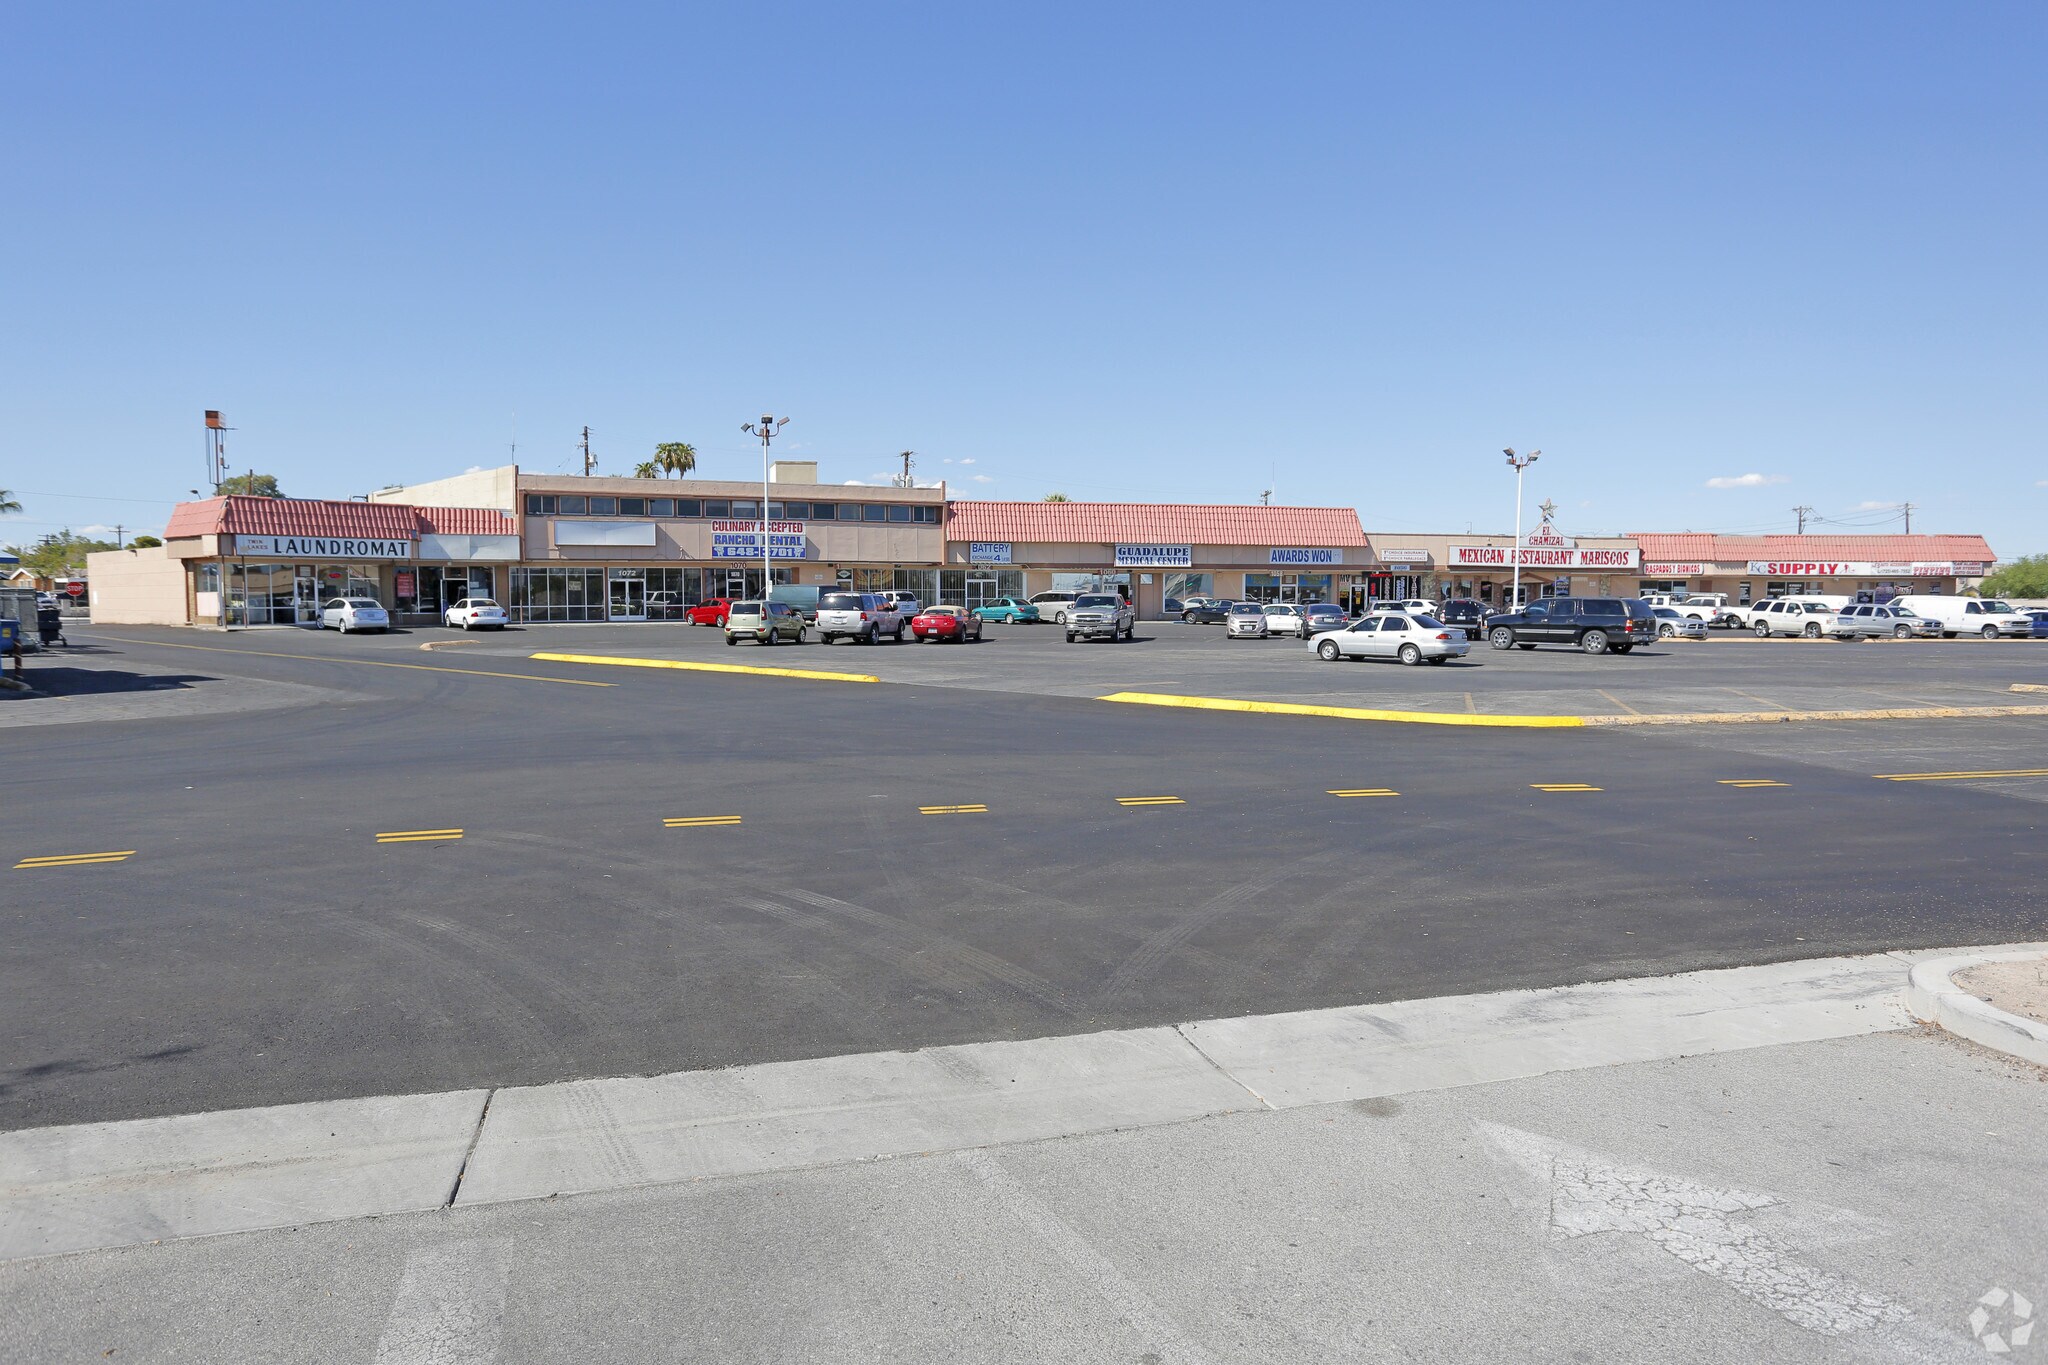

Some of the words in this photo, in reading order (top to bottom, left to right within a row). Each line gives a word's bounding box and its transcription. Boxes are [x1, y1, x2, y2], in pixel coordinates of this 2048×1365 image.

[712, 521, 756, 532] CULINARY
[1542, 526, 1551, 535] EL
[714, 534, 755, 545] RANCHO
[1528, 536, 1564, 546] CHAMIZAL
[274, 538, 407, 556] LAUNDROMAT
[972, 543, 1009, 553] BATTERY
[1118, 547, 1189, 556] GUADALUPE
[993, 554, 1001, 562] 4
[1118, 556, 1154, 565] MEDICAL
[1157, 557, 1189, 566] CENTER
[1271, 549, 1310, 563] AWARDS
[1312, 550, 1332, 563] WON
[1459, 548, 1505, 563] MEXICAN
[1581, 550, 1629, 566] MARISCOS
[1646, 563, 1672, 574] RASPADOS
[1672, 565, 1676, 573] Y
[1677, 564, 1700, 574] BIONICOS
[1767, 562, 1839, 575] SUPPLY
